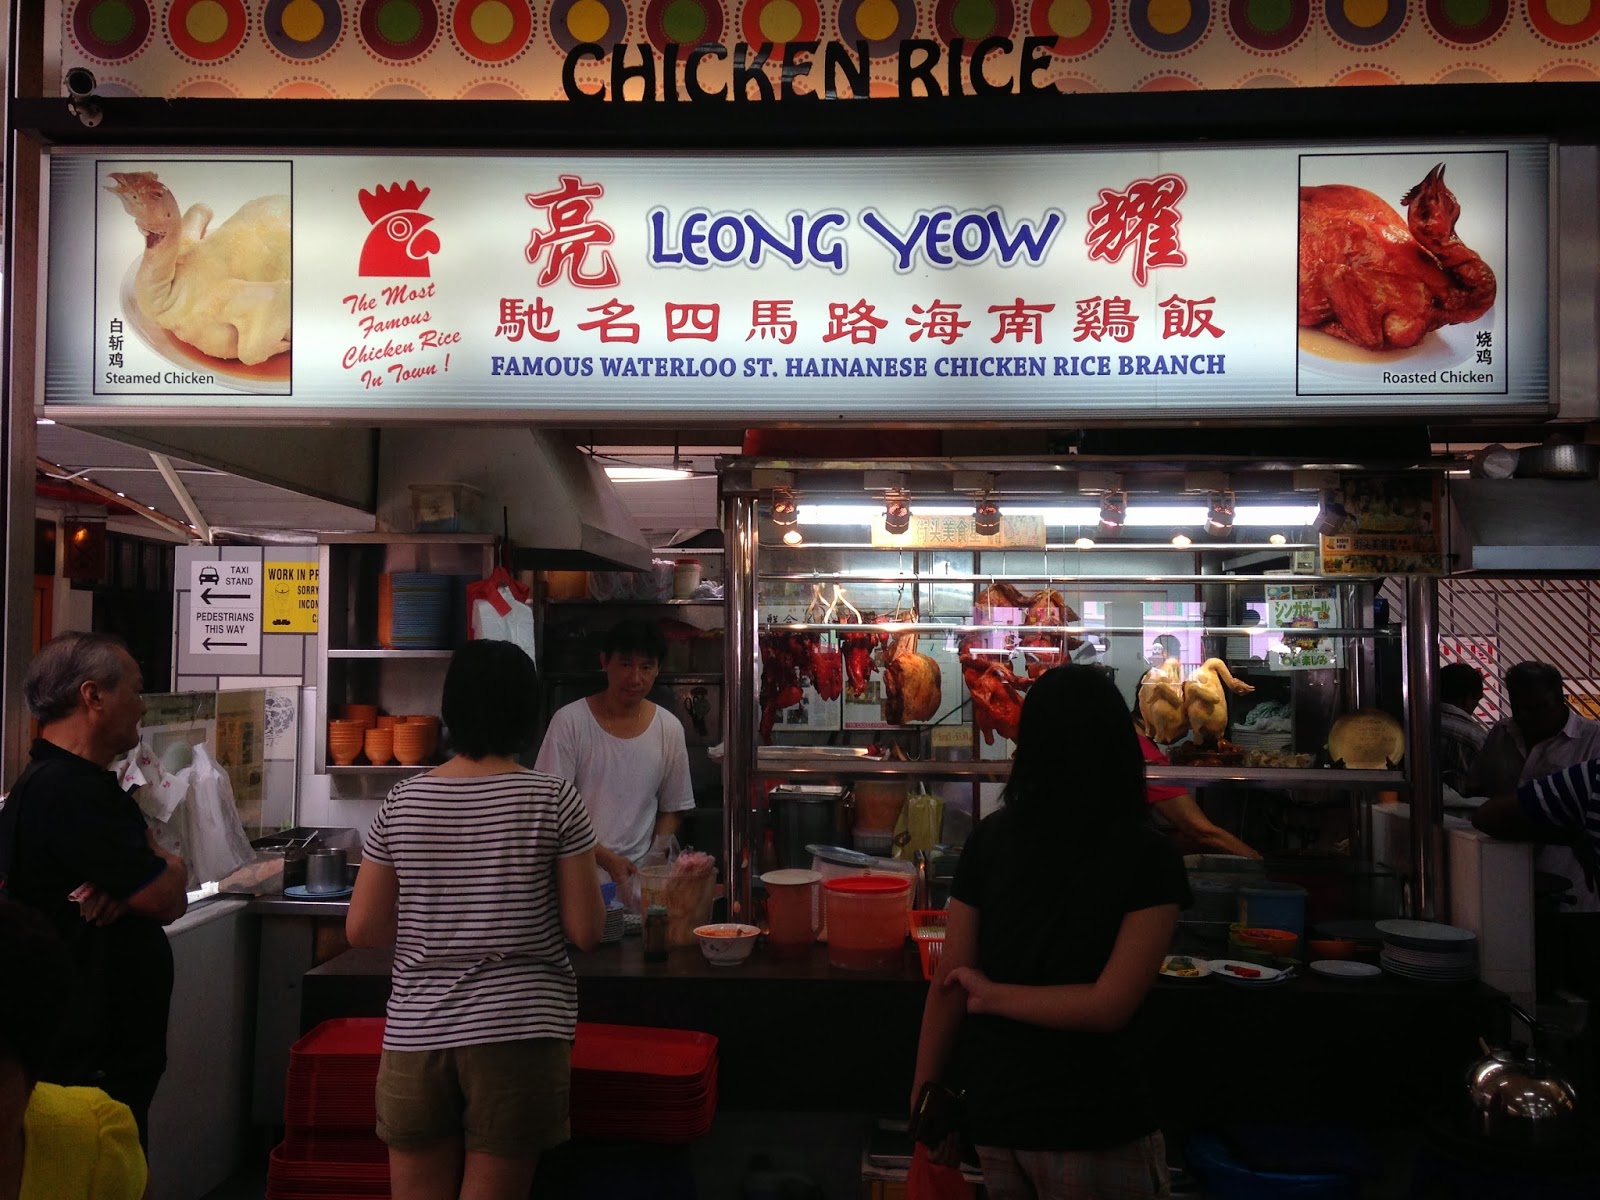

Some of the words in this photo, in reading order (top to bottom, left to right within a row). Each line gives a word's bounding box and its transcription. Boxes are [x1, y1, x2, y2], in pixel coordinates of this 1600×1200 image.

[562, 41, 870, 101] CHICKEN
[900, 36, 1059, 98] RICE
[526, 174, 620, 288] 亮
[652, 211, 845, 269] LEONG
[864, 211, 1061, 269] YEOW
[342, 293, 377, 314] The
[381, 282, 436, 306] Most
[358, 311, 432, 339] Famous
[109, 318, 124, 368] 白斩鸡
[342, 339, 415, 369] Chicken
[418, 329, 461, 351] Rice
[1476, 331, 1492, 365] 烧鸡
[105, 372, 161, 384] Steamed
[164, 371, 214, 384] Chicken
[360, 370, 383, 389] In
[387, 363, 437, 383] Town
[491, 356, 594, 377] FAMOUS
[600, 357, 737, 377] WATERLOO
[743, 357, 778, 377] ST.
[785, 357, 927, 377] HAINANESE
[934, 357, 1047, 377] CHICKEN
[1053, 356, 1111, 376] RICE
[1118, 354, 1226, 376] BRANCH
[1383, 371, 1437, 383] Roasted
[1440, 370, 1494, 383] Chicken
[225, 577, 253, 586] STAND
[230, 566, 249, 574] TAXI
[268, 568, 294, 581] WORK
[297, 569, 306, 580] IN
[297, 585, 319, 595] SORRY
[196, 612, 254, 622] PEDESTRIANS
[205, 625, 224, 634] THIS
[226, 625, 245, 634] WAY
